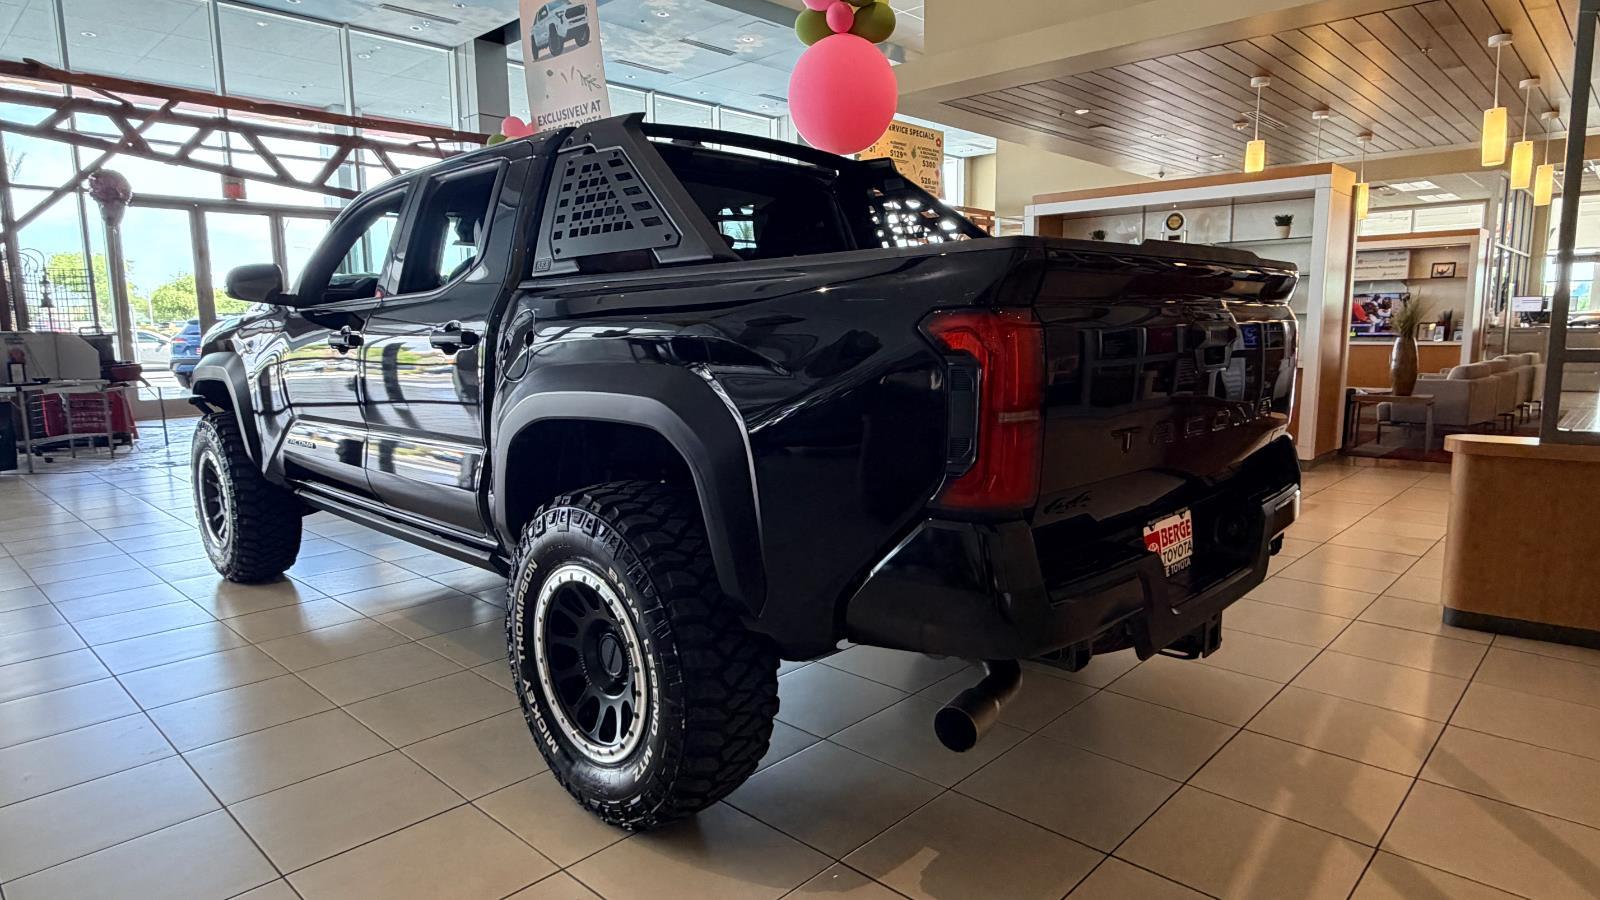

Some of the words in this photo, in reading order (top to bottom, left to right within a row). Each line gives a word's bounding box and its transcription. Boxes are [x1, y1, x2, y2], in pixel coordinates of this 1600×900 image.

[537, 103, 588, 126] EXCLUSIVELY
[591, 99, 601, 113] AT
[889, 124, 909, 135] RVICE
[909, 128, 935, 140] SPECIALS
[922, 160, 936, 169] $300
[1160, 519, 1191, 548] BERGE
[1162, 540, 1193, 565] TOYOTA
[1171, 556, 1192, 574] TOYOTA
[608, 566, 640, 624] BAJA
[516, 558, 538, 664] THOMPSON
[643, 638, 660, 736] LEGEND
[523, 679, 559, 754] MICKEY
[632, 744, 653, 782] MTZ
